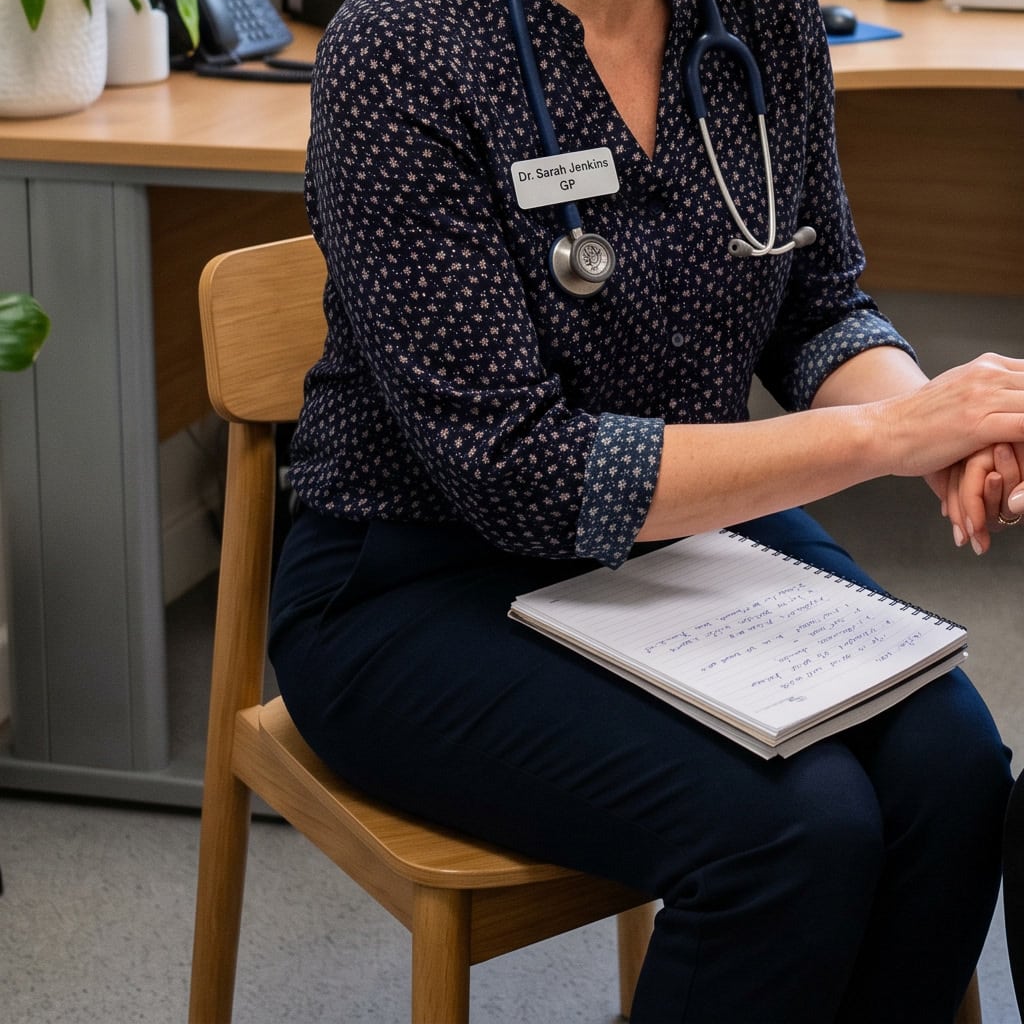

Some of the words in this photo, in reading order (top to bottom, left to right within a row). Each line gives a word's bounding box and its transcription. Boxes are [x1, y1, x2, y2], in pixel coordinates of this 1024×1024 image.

[518, 171, 534, 182] Dr.
[536, 165, 567, 179] Sarah
[569, 159, 609, 173] Jenkins
[559, 179, 576, 191] GP
